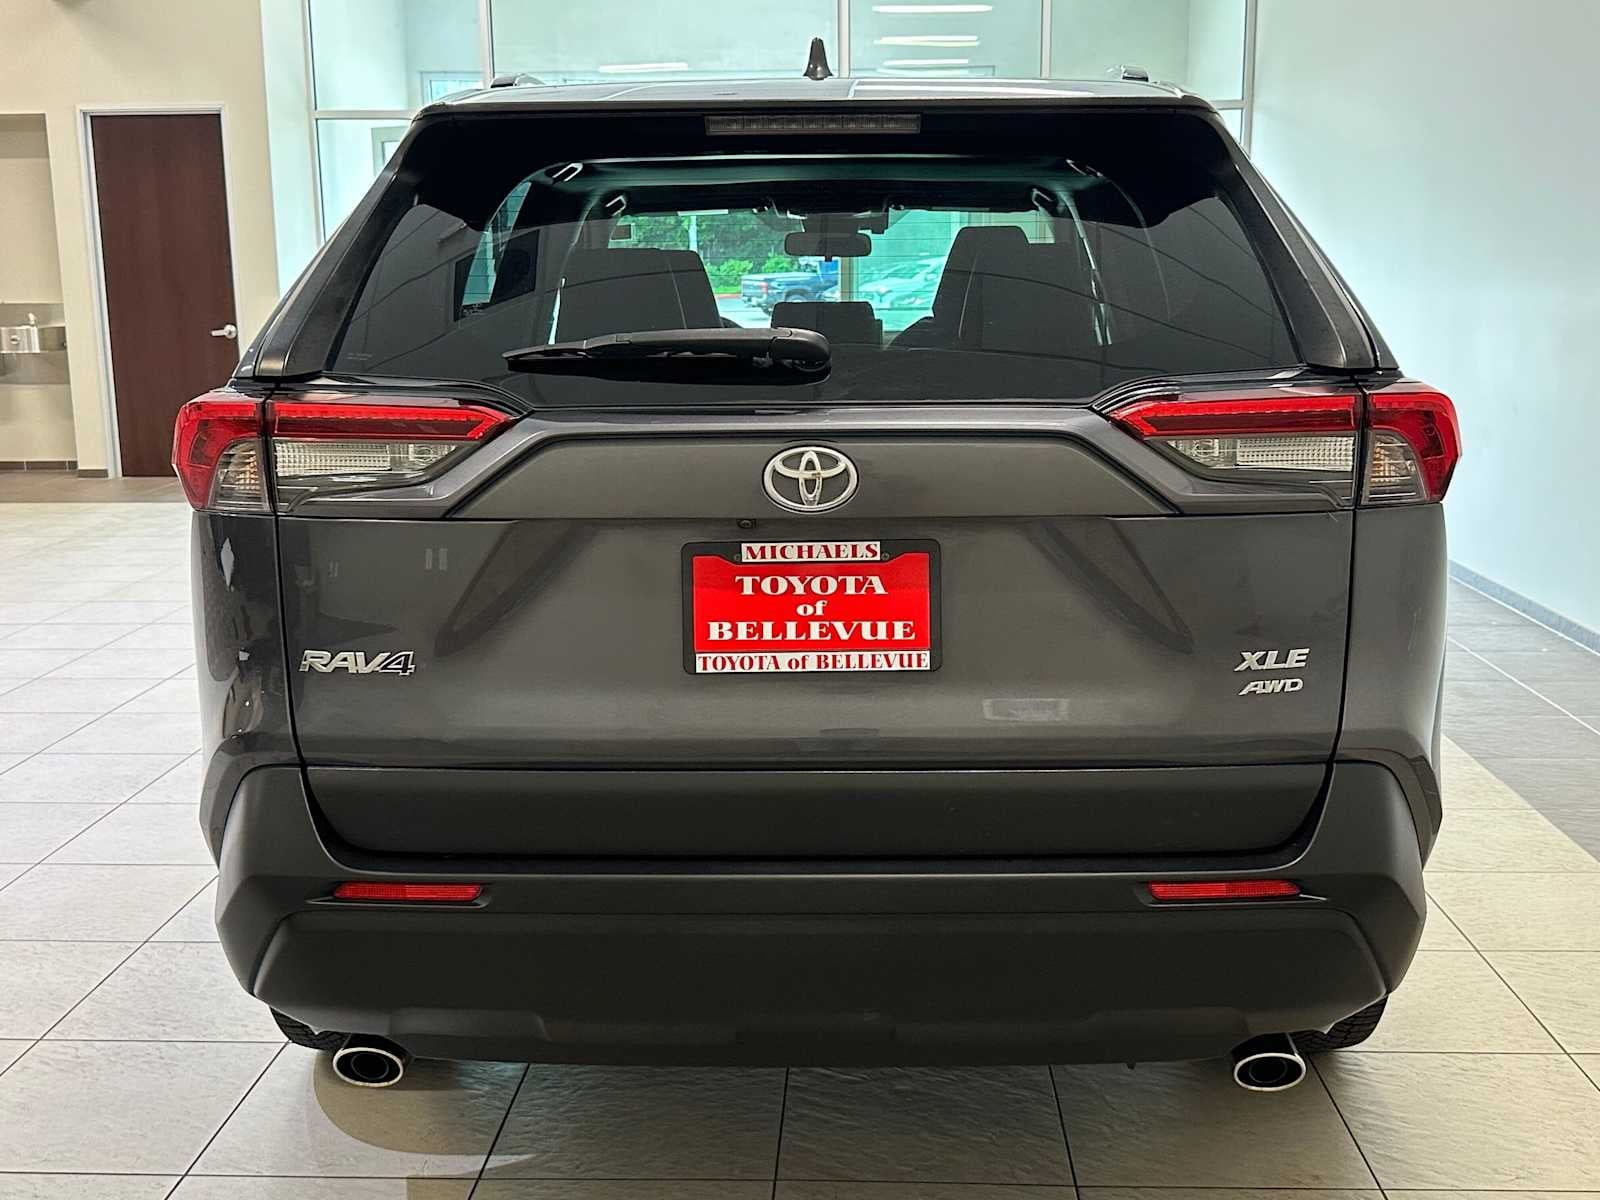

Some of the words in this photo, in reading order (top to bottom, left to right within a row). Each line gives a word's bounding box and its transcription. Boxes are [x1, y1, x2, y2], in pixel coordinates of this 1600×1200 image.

[745, 543, 878, 561] MICHAELS
[735, 575, 888, 595] TOYOTA
[796, 600, 827, 616] of
[707, 620, 916, 640] BELLEVUE
[299, 649, 416, 676] RAV4
[697, 655, 780, 671] TOYOTA
[787, 654, 810, 670] of
[816, 653, 929, 670] BELLEVUE
[1233, 648, 1310, 672] XLE
[1238, 678, 1304, 696] AWD
